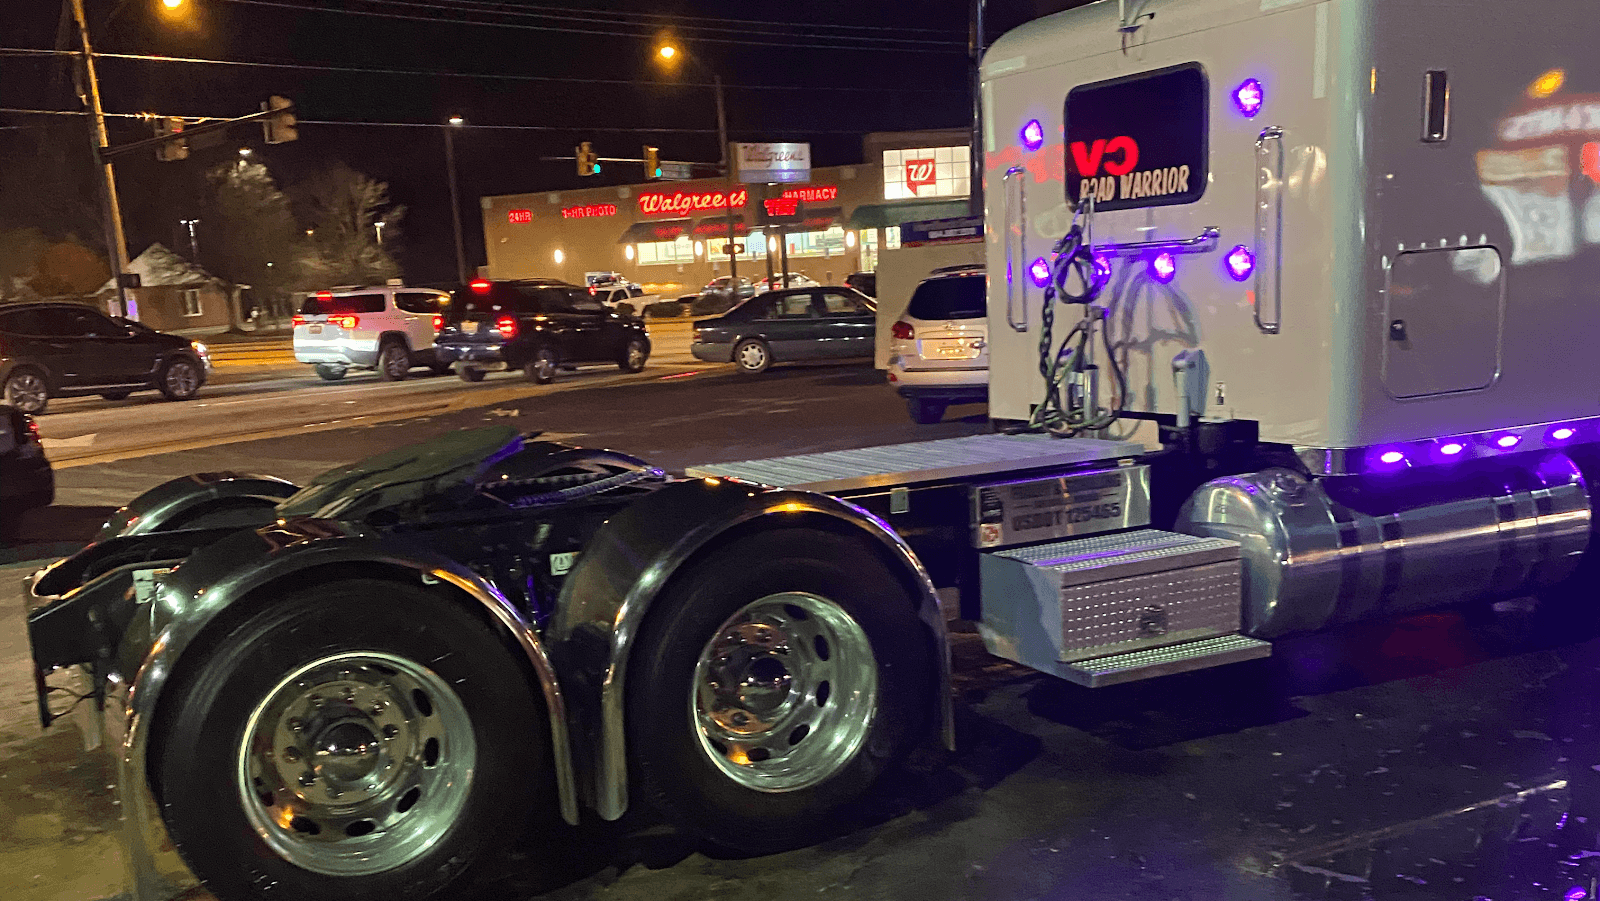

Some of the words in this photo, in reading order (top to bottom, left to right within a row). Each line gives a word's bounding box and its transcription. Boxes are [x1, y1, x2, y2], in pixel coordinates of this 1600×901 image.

[1080, 176, 1115, 203] ROAD
[1120, 165, 1190, 200] WARRIOR
[783, 187, 837, 201] HARMACY
[508, 210, 532, 224] 24HR
[586, 205, 616, 217] PHOTO
